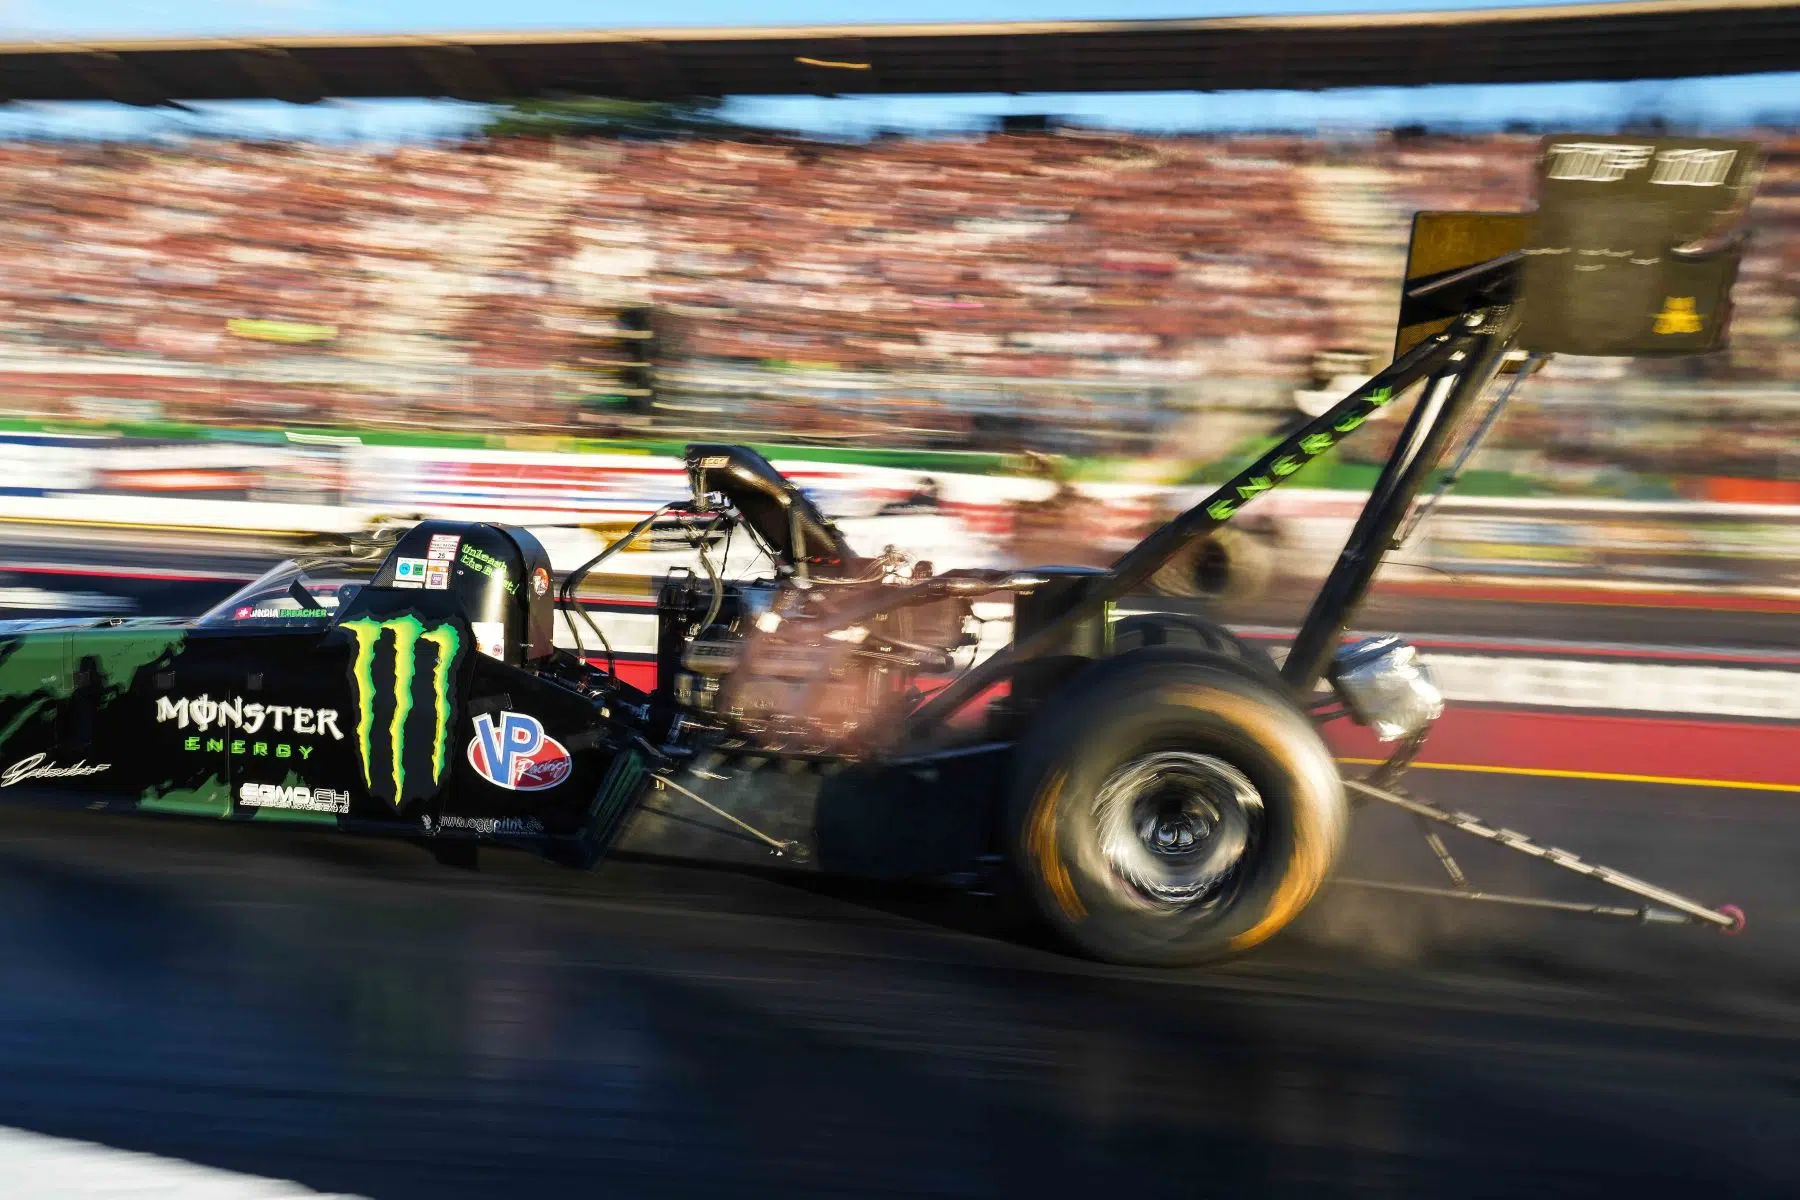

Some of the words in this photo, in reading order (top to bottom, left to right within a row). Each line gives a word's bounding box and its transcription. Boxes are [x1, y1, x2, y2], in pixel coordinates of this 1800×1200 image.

[156, 693, 344, 741] MONSTER
[184, 736, 313, 760] ENERGY
[472, 710, 545, 787] VP
[515, 758, 569, 781] Racing
